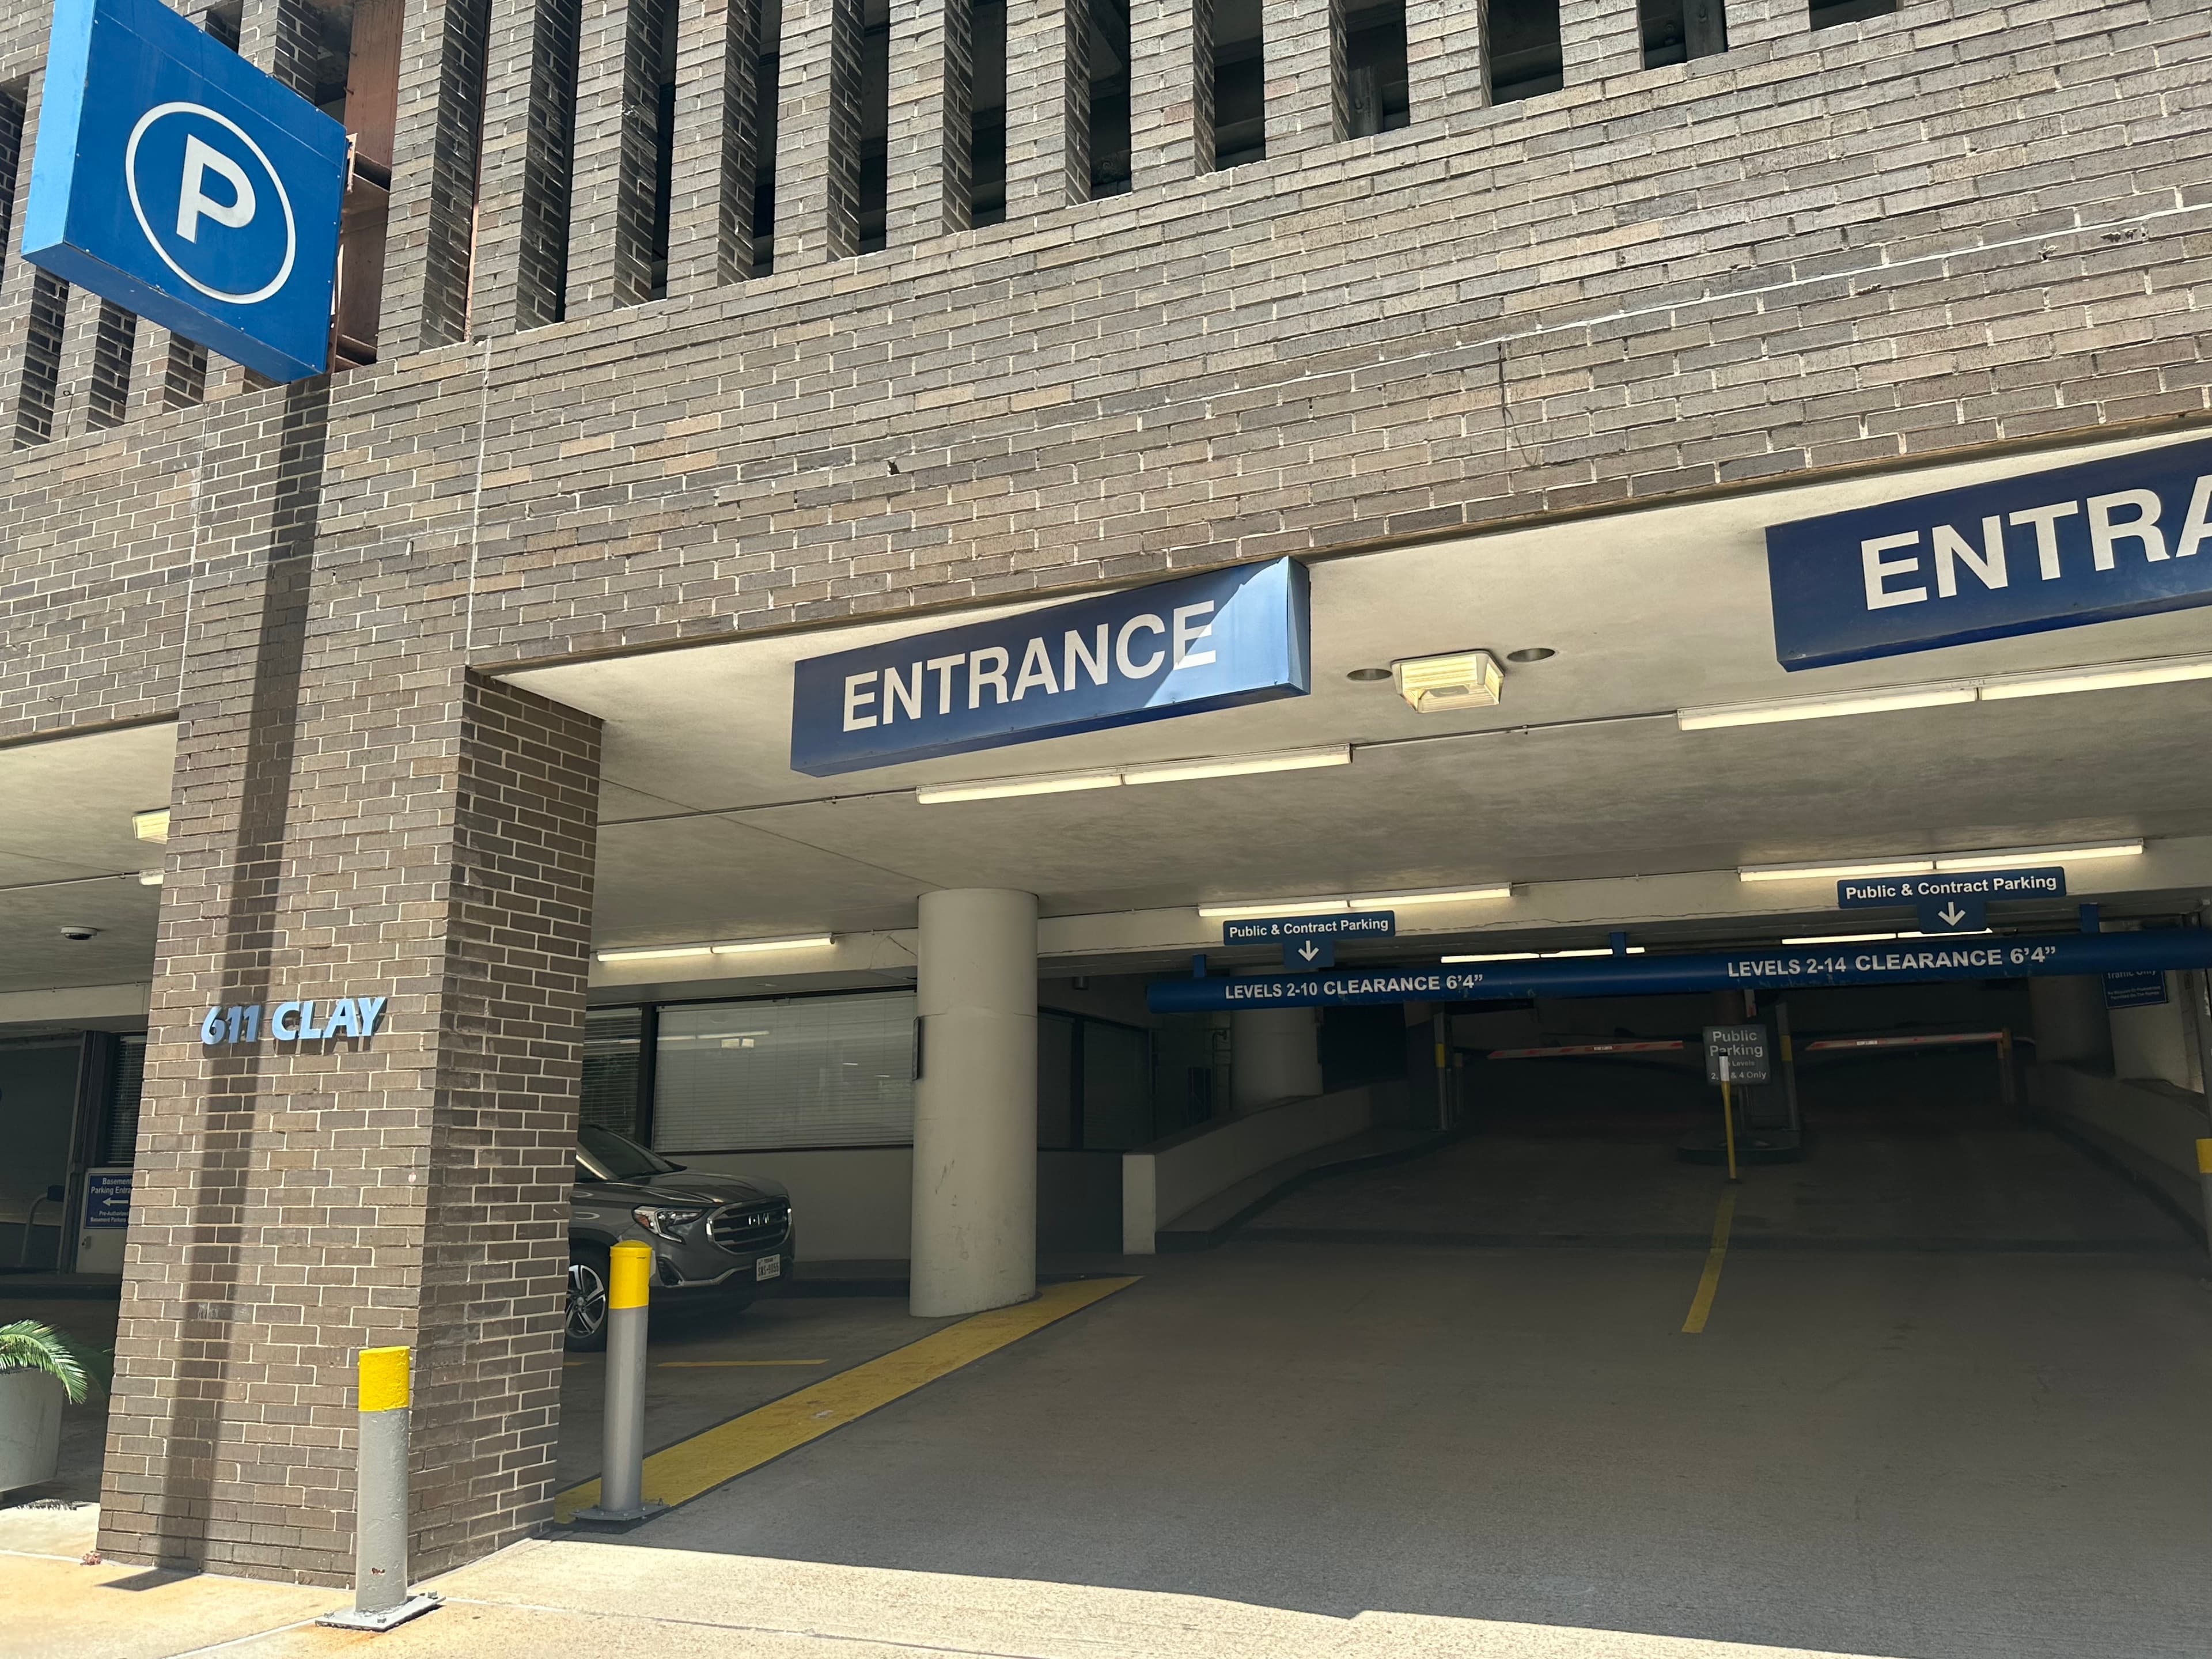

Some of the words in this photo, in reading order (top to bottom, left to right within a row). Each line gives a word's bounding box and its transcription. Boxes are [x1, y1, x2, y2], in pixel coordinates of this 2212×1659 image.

[176, 134, 256, 243] P
[843, 600, 1217, 732] ENTRANCE
[1846, 884, 1896, 900] Public
[1901, 884, 1913, 896] &
[1917, 879, 1988, 895] Contract
[1993, 876, 2057, 892] Parking
[1229, 925, 1267, 938] Public
[1271, 924, 1280, 935] &
[1283, 921, 1337, 934] Contract
[1340, 918, 1389, 933] Parking
[1728, 959, 1800, 978] LEVELS
[1806, 959, 1846, 974] 2-14
[1855, 949, 2002, 971] CLEARANCE
[1225, 983, 1282, 999] LEVELS
[1286, 982, 1317, 997] 2-10
[1324, 976, 1440, 995] CLEARANCE
[201, 1005, 261, 1045] 611
[272, 997, 385, 1041] CLAY
[1713, 1031, 1758, 1042] Public
[1709, 1044, 1763, 1058] Parking
[1747, 1071, 1767, 1080] Only
[91, 1186, 113, 1196] Parking
